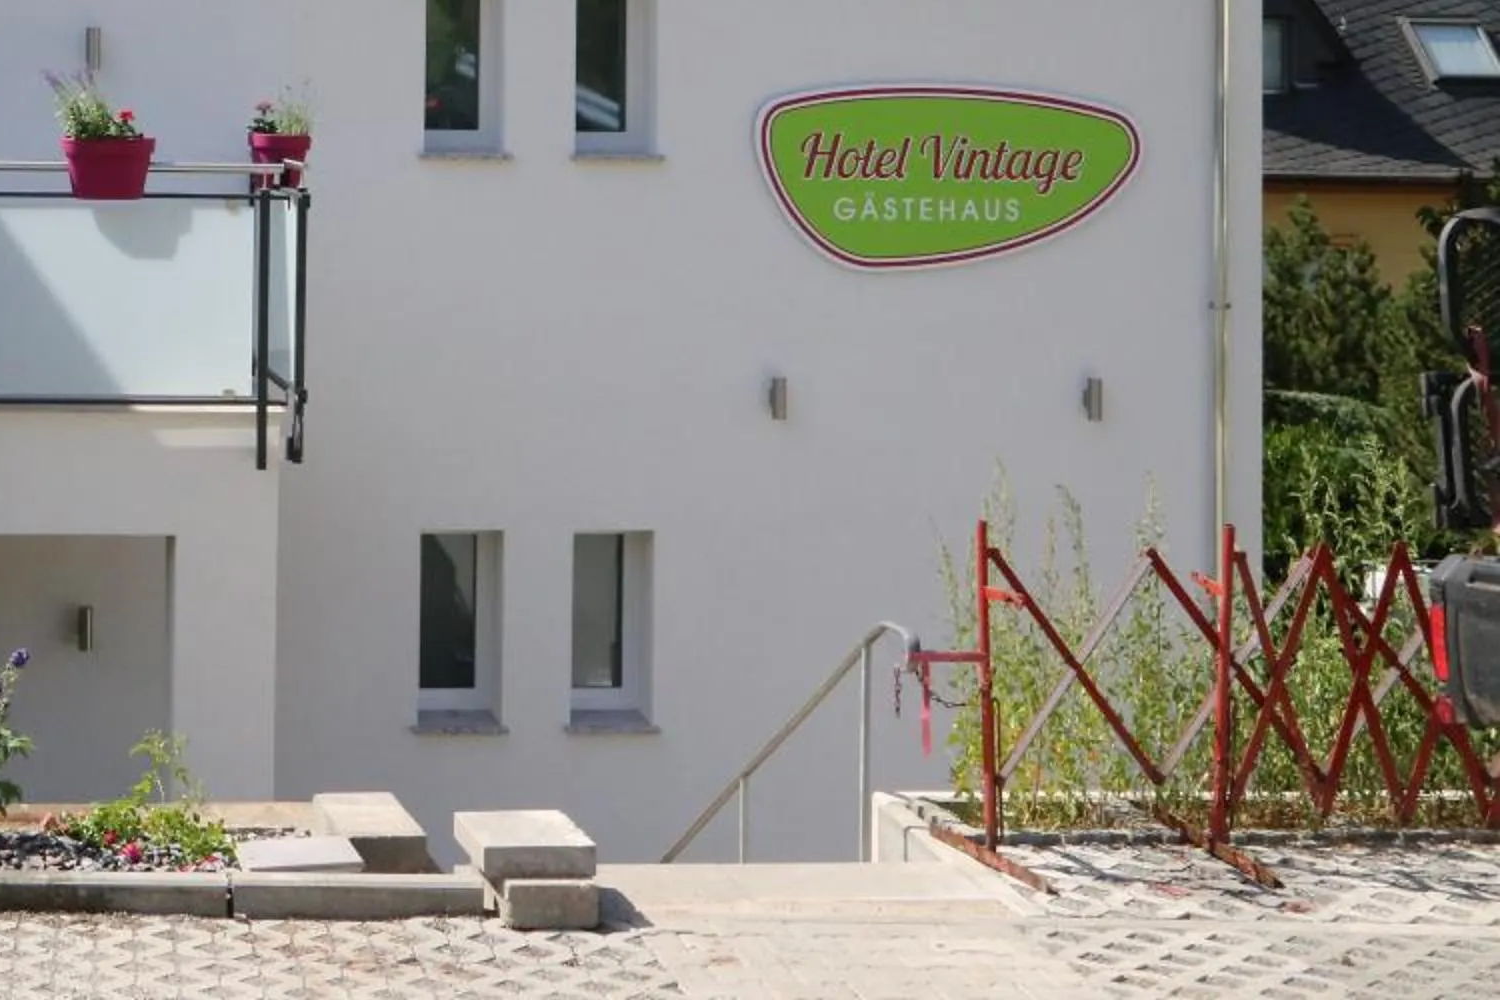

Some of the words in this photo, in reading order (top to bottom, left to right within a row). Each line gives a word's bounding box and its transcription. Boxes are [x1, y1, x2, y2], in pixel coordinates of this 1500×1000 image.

[801, 131, 911, 180] Hotel
[920, 134, 1084, 195] Vintage
[833, 192, 1020, 222] GÄSTEHAUS
